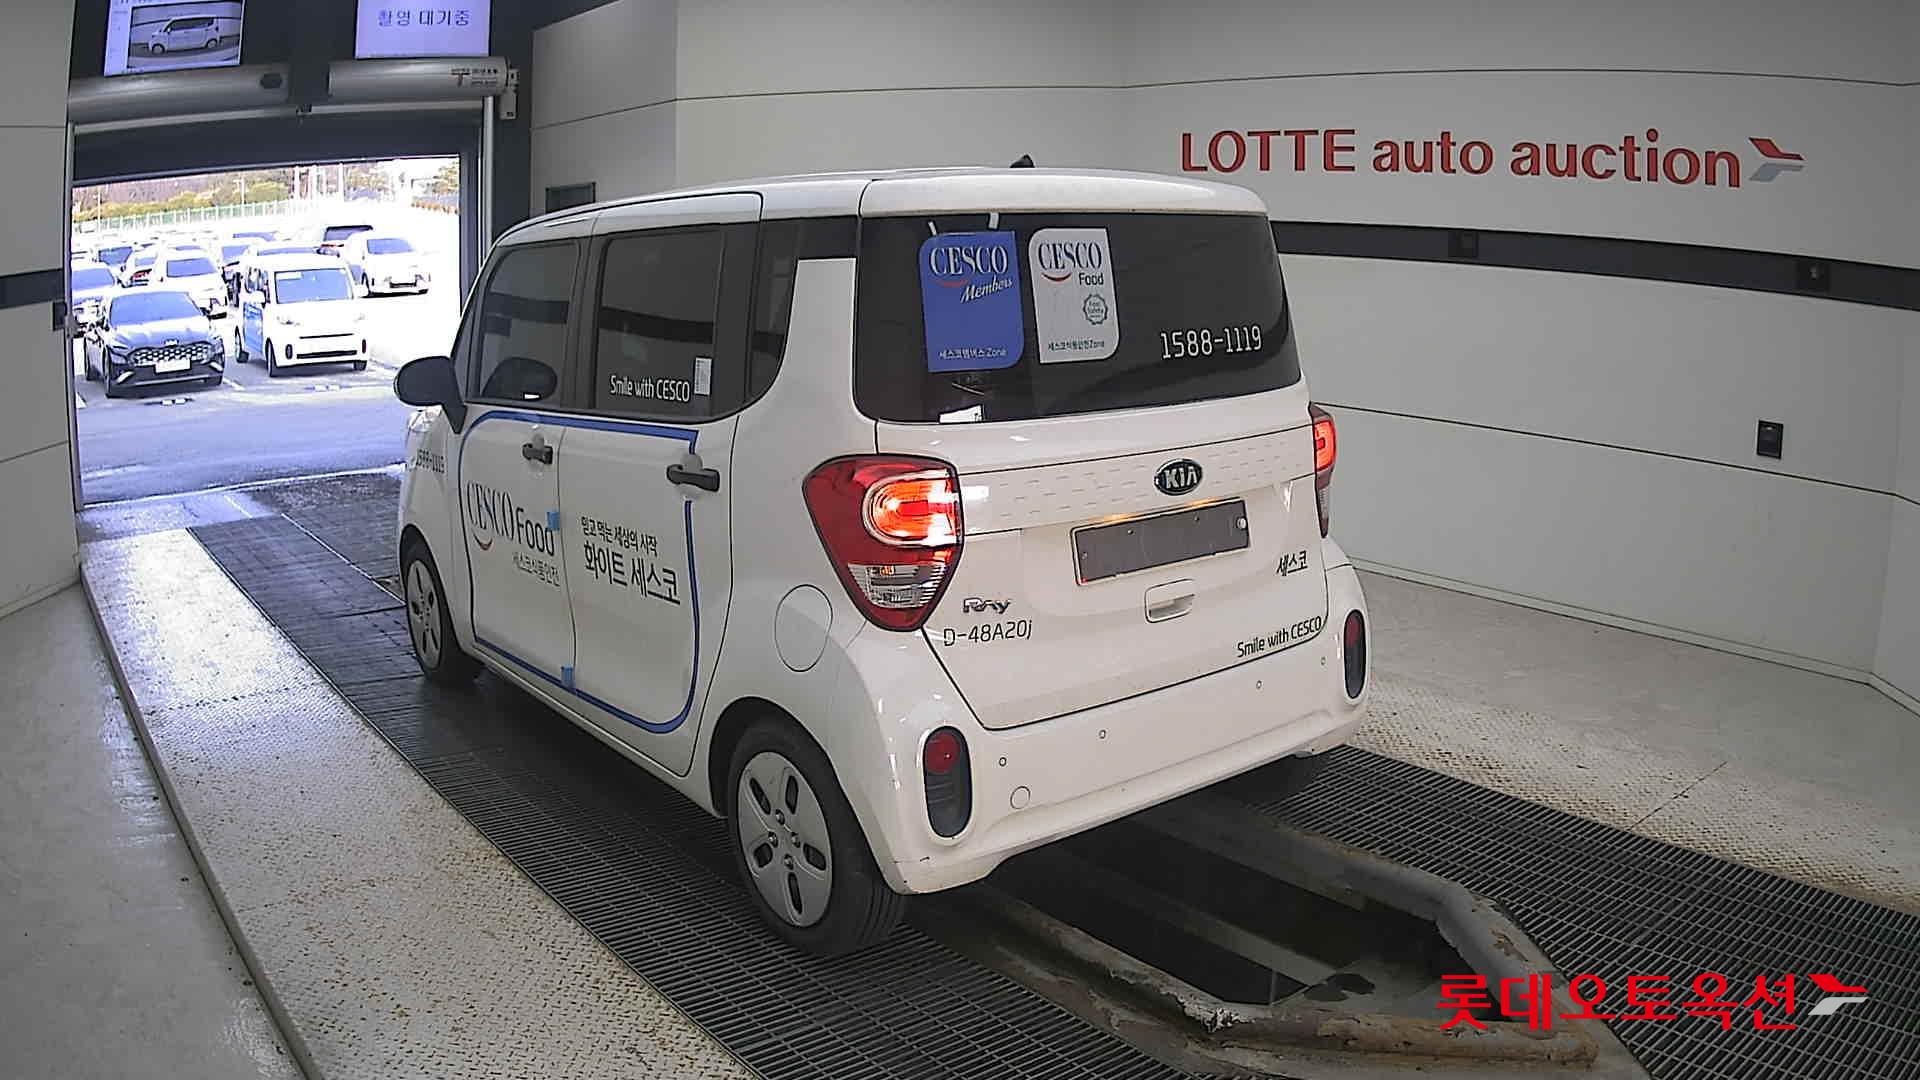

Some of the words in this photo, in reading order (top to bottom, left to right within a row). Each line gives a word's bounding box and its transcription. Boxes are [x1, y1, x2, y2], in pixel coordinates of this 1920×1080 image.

[418, 9, 471, 26] 대기중
[1180, 128, 1356, 173] LOTTE
[1372, 131, 1494, 176] auto
[1510, 128, 1741, 188] auction
[929, 246, 1008, 276] CESCO
[1037, 242, 1102, 271] CESCO
[960, 276, 1013, 304] Members
[1079, 271, 1104, 286] Food
[1160, 325, 1262, 359] 1588-1119
[610, 375, 633, 396] Smile
[634, 379, 655, 399] with
[656, 379, 690, 402] CESCO
[466, 482, 515, 541] CESCO
[639, 533, 658, 557] 시작
[584, 540, 628, 586] 화이트
[630, 557, 681, 606] 세스코
[1276, 550, 1308, 577] 세스코
[943, 619, 1032, 647] D-48A20j
[1237, 637, 1265, 658] Smile
[1267, 628, 1289, 648] with
[1290, 616, 1322, 640] CESCO
